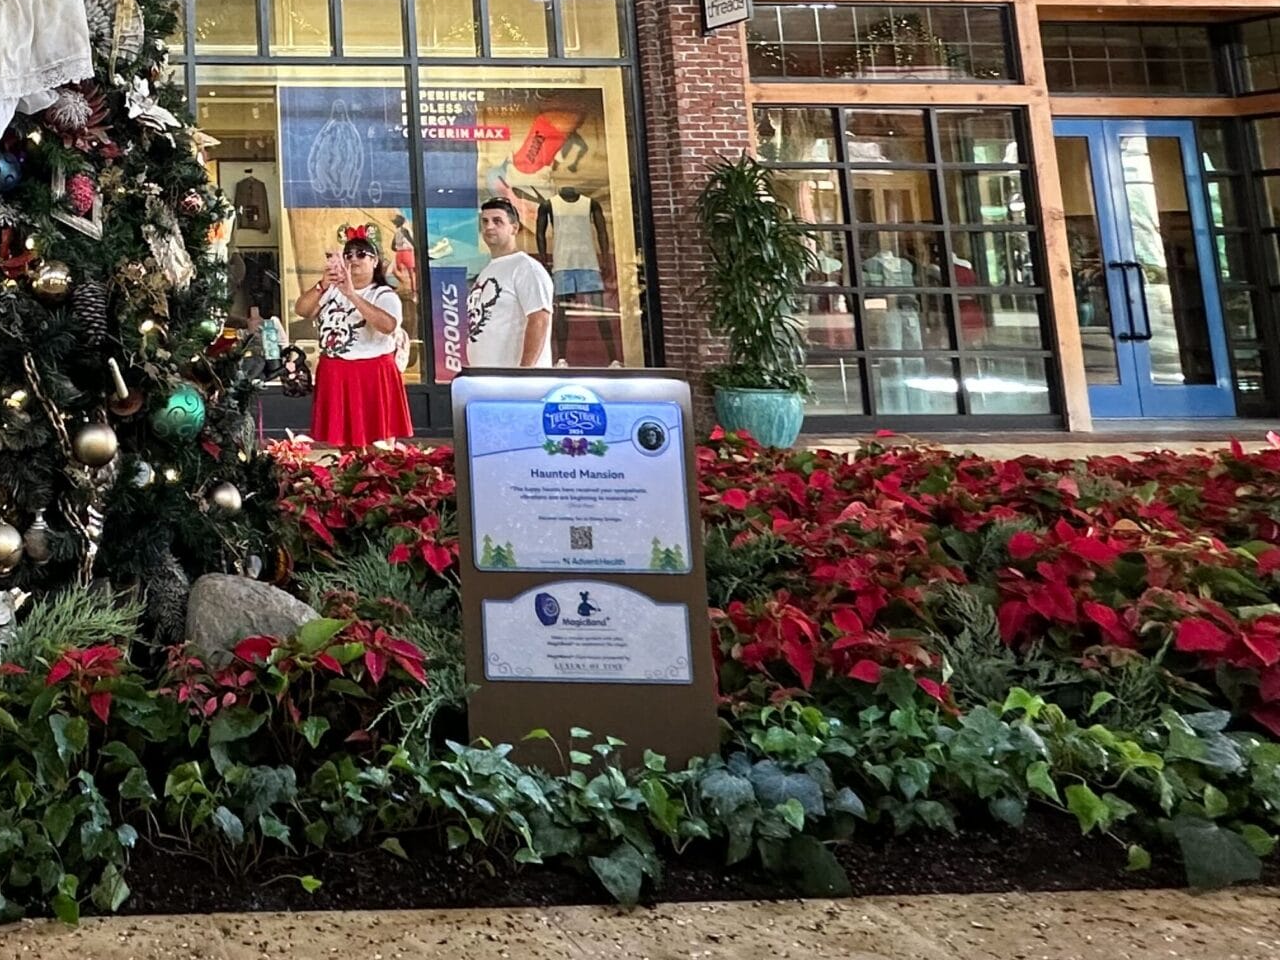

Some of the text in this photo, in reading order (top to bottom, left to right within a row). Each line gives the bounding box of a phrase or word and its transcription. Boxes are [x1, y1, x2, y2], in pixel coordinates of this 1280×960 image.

[401, 91, 485, 101] EPERIENCE
[473, 128, 504, 139] MAX
[442, 281, 462, 372] BROOKS
[530, 468, 625, 480] Haunted Mansion
